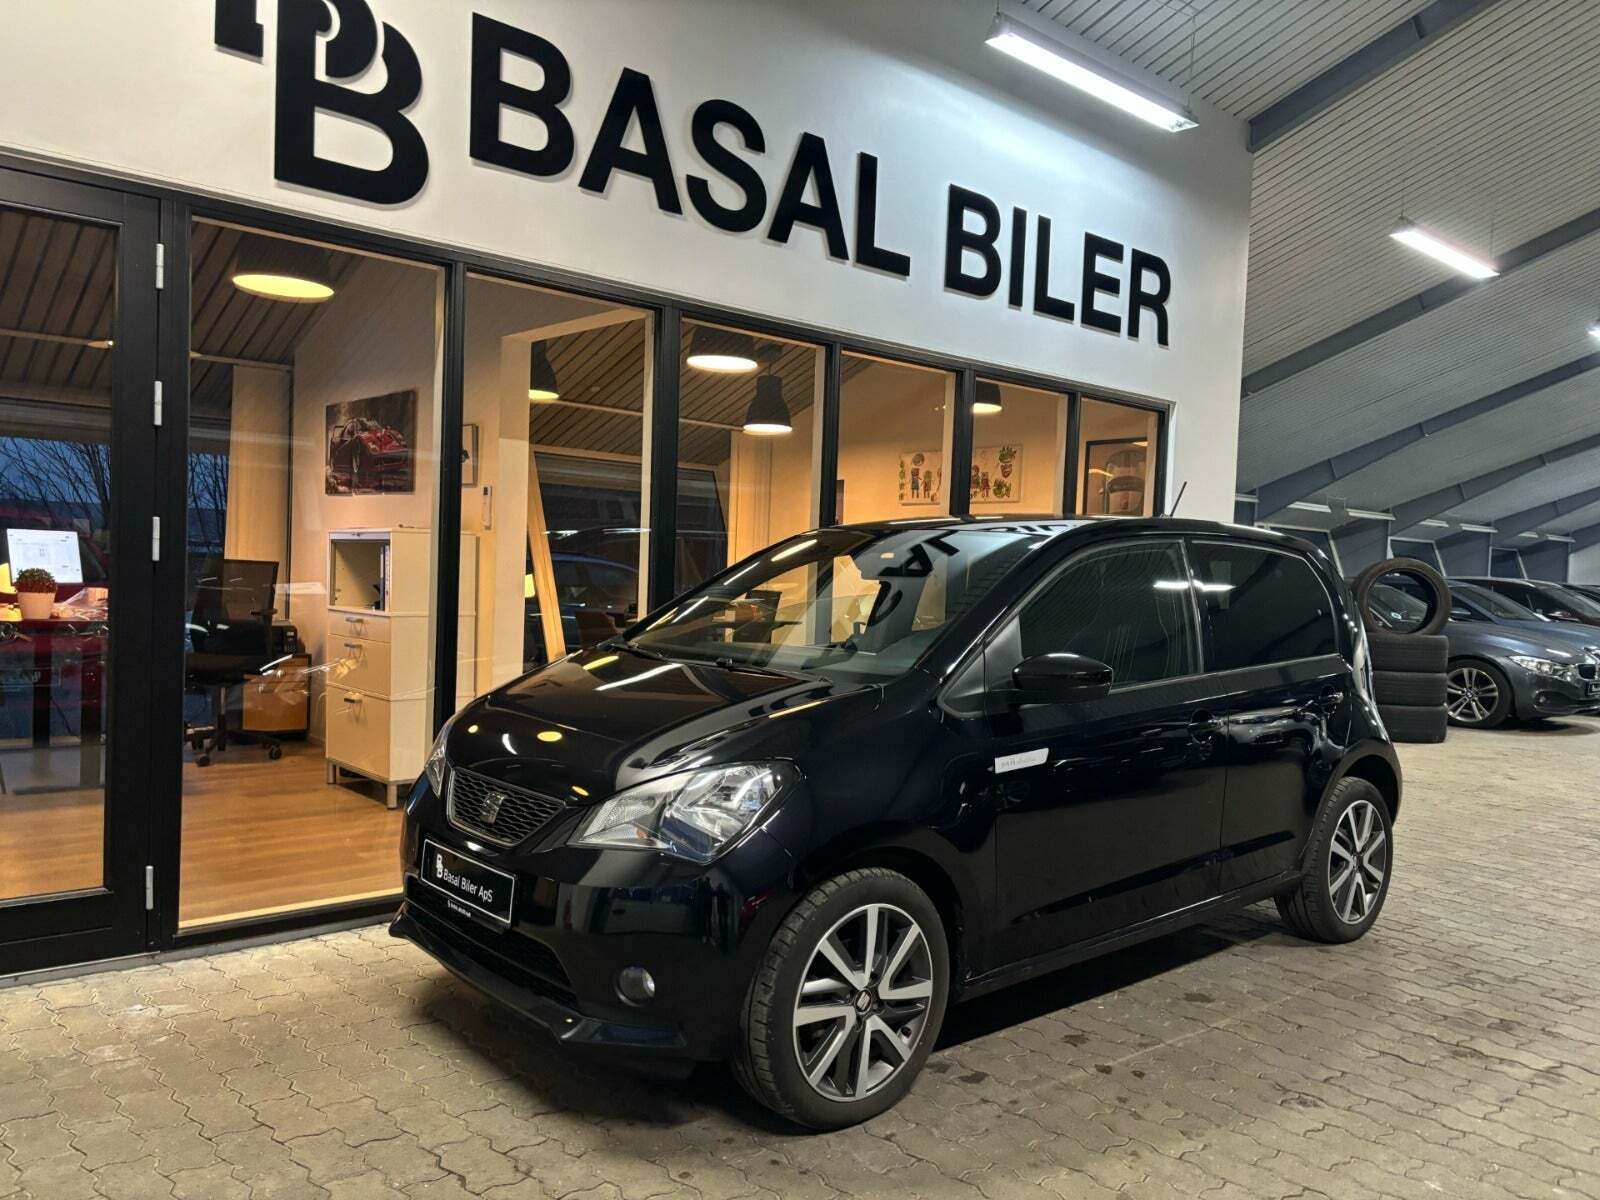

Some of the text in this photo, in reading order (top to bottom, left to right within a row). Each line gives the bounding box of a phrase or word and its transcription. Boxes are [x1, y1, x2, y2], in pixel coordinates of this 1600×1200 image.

[469, 12, 1171, 346] BASAL BILER
[443, 868, 493, 902] Basal Biler ApS
